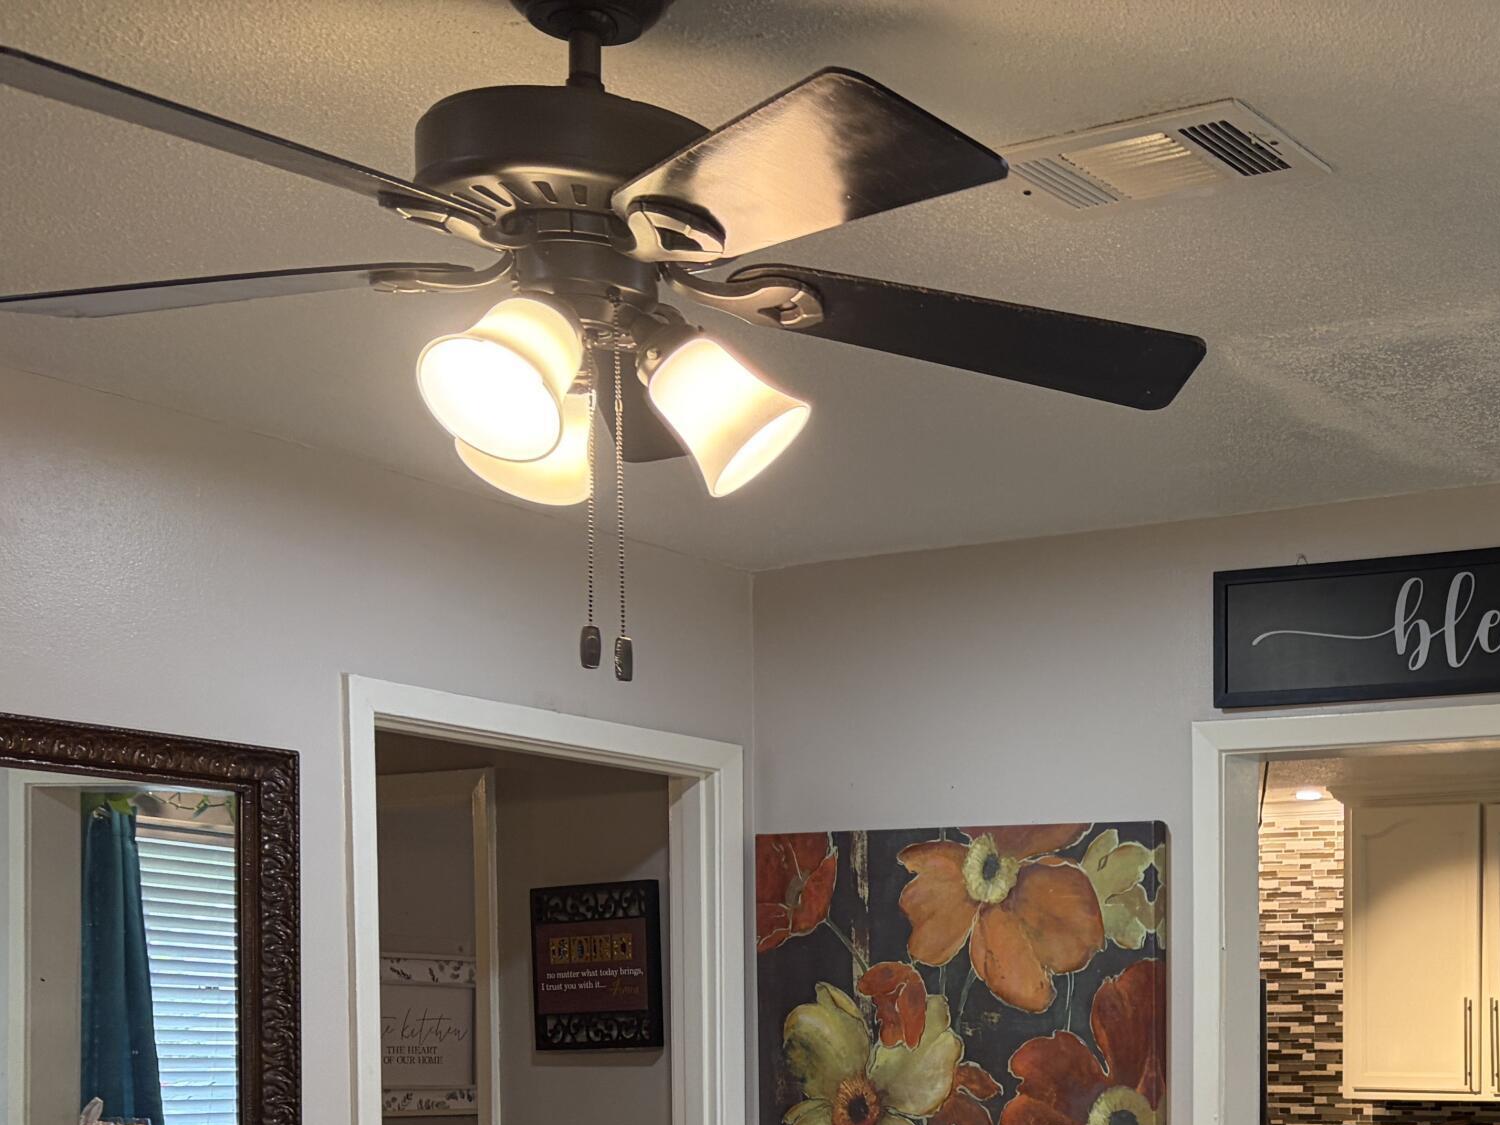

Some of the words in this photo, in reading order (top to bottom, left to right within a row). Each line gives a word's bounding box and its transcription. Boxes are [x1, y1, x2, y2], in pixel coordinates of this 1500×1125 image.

[556, 970, 580, 979] matter
[580, 968, 598, 977] what
[599, 967, 619, 978] today
[546, 982, 563, 991] trust
[563, 983, 577, 992] you
[577, 981, 593, 989] with
[386, 1046, 405, 1055] THE
[407, 1046, 438, 1055] HEART
[383, 1056, 395, 1065] OF
[396, 1056, 416, 1065] OUR
[417, 1056, 444, 1065] HOME
